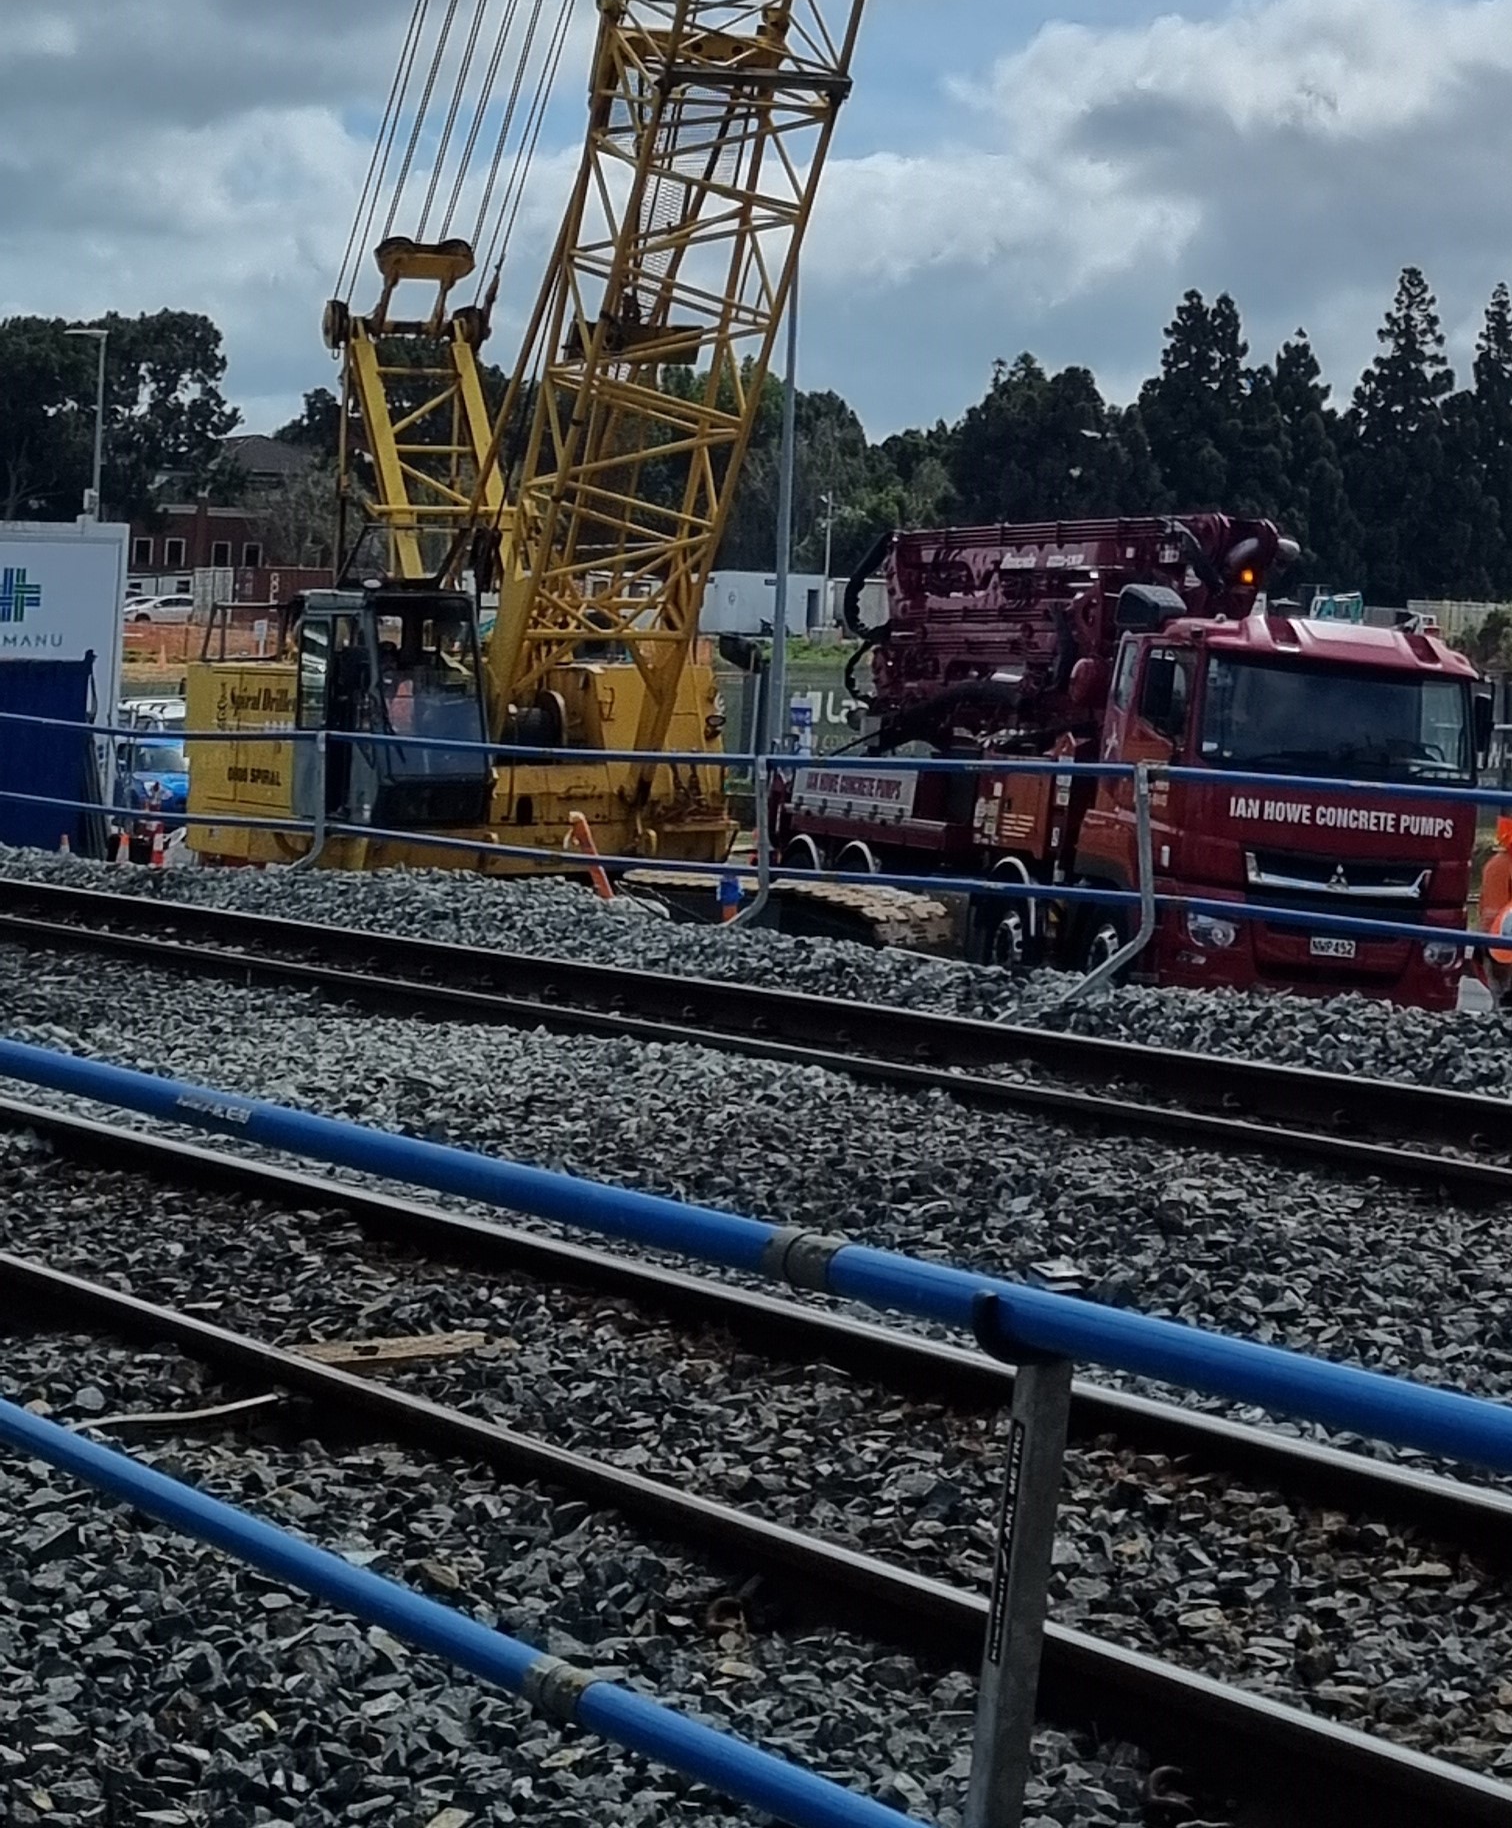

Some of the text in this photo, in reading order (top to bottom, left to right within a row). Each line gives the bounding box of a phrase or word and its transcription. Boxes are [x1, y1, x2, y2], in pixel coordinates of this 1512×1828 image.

[230, 686, 262, 717] Spiral
[1229, 796, 1454, 839] IAN HOWE CONCRETE PUMPS
[1008, 1426, 1022, 1495] METRO
[1003, 1502, 1014, 1540] AKL
